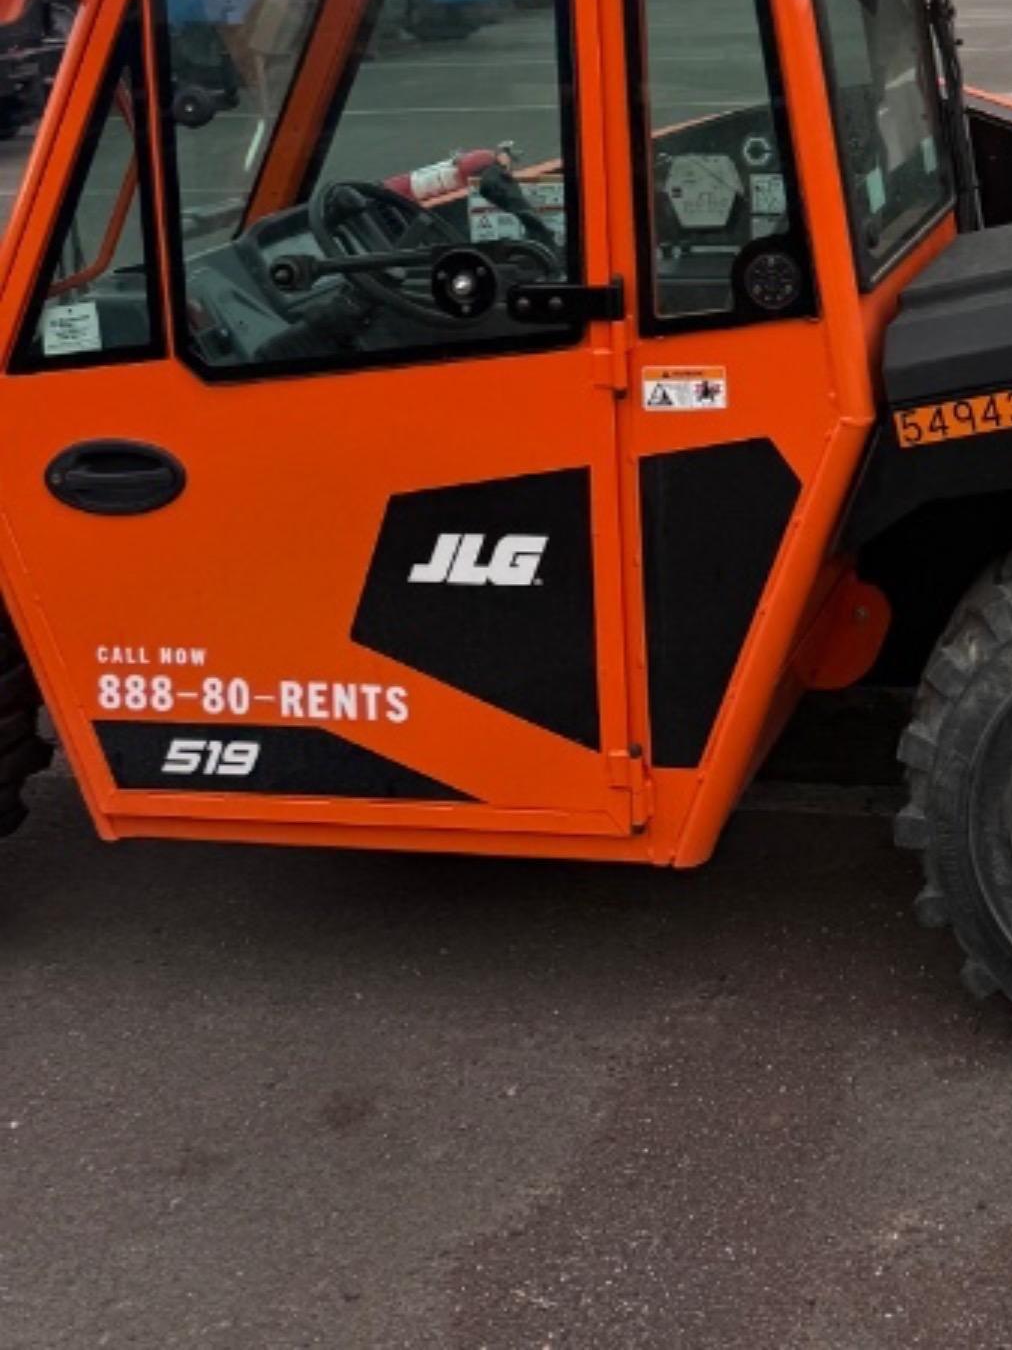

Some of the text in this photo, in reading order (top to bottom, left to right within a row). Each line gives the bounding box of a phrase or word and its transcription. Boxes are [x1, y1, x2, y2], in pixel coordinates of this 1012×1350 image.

[407, 532, 549, 585] JLG
[97, 646, 207, 667] CALL NOW
[98, 673, 409, 723] 888-80-RENTS
[161, 739, 261, 775] 519
